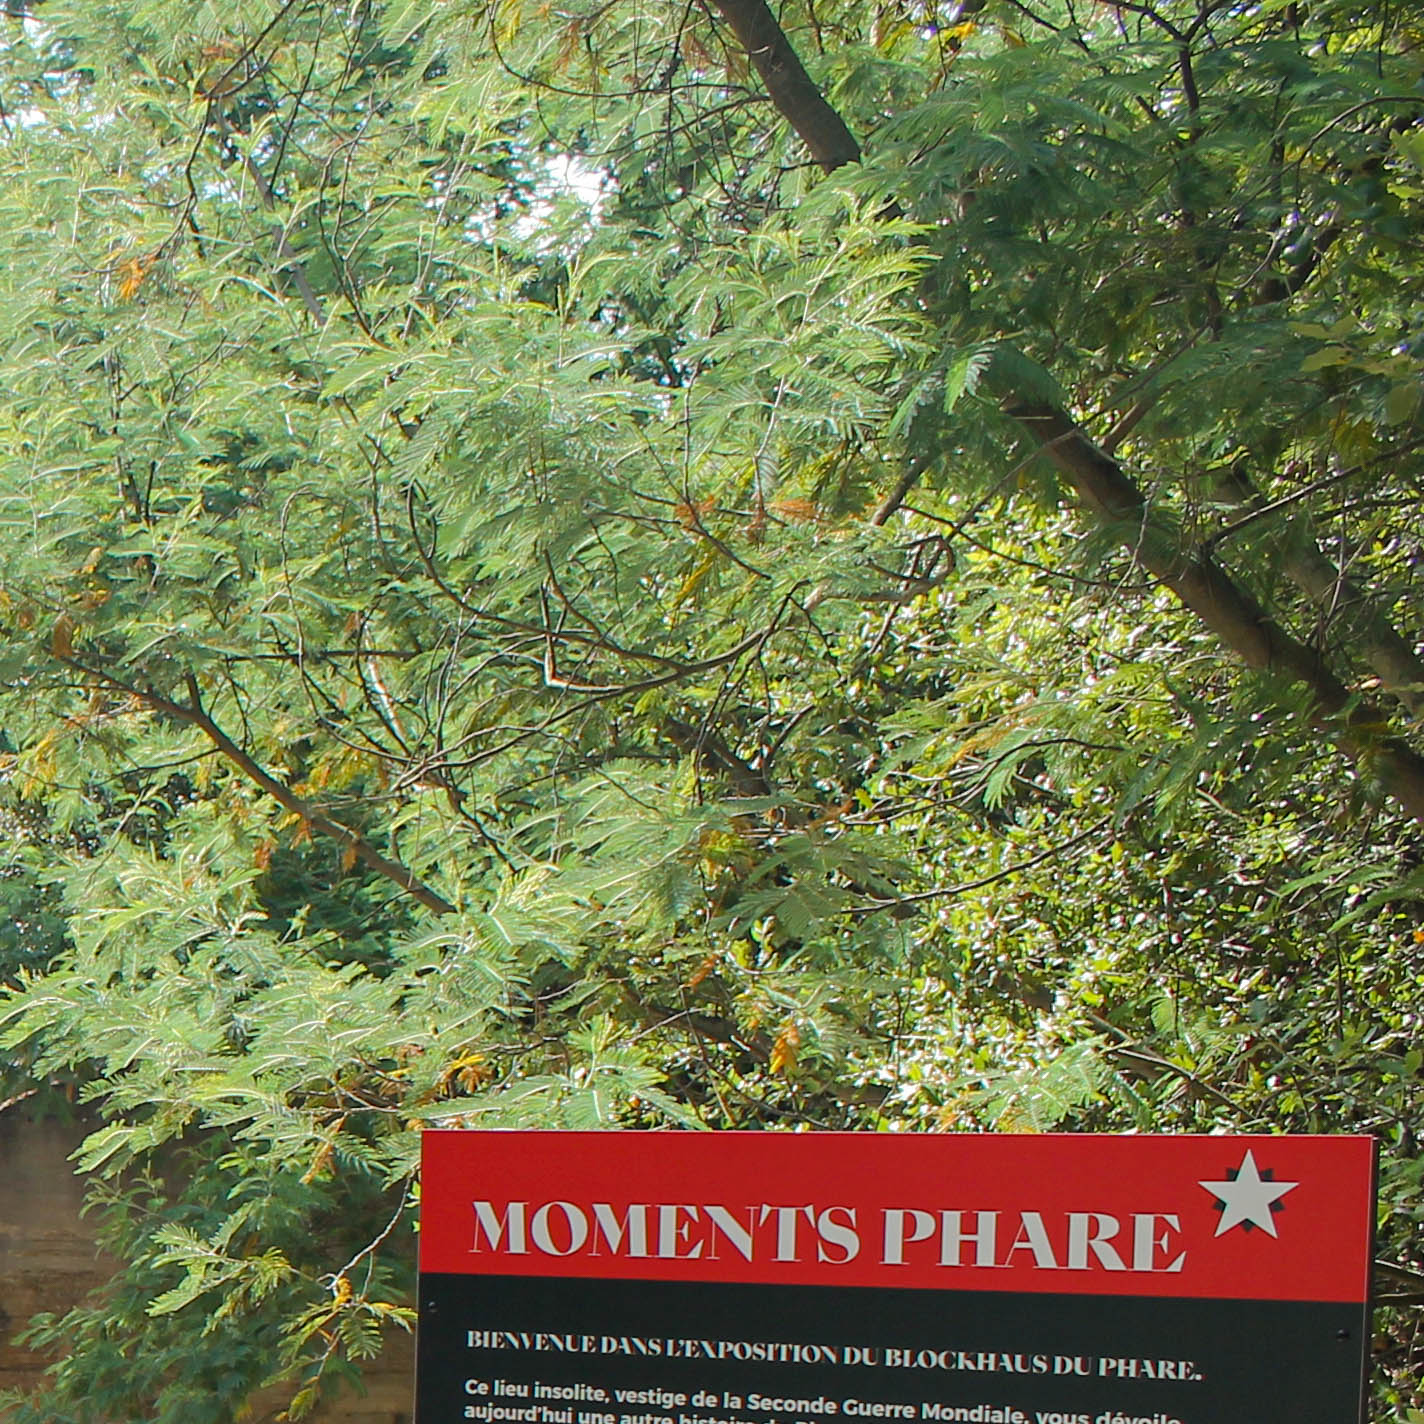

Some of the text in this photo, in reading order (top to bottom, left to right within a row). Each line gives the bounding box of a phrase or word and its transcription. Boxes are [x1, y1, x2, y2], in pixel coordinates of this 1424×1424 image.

[469, 1201, 1186, 1273] MOMENTS PHARE
[467, 1330, 597, 1353] BIENVENUE
[601, 1336, 662, 1356] DANS
[844, 1346, 877, 1366] DU
[885, 1348, 1048, 1374] BLOCKHAUS
[1054, 1355, 1090, 1376] DU
[1098, 1357, 1202, 1381] PHARE.
[465, 1379, 489, 1395] Ce
[494, 1379, 529, 1398] lieu
[534, 1381, 610, 1404] insolite,
[614, 1387, 687, 1410] vestige
[691, 1390, 718, 1408] de
[723, 1391, 742, 1410] la
[747, 1393, 838, 1415] Seconde
[842, 1399, 916, 1419] Guerre
